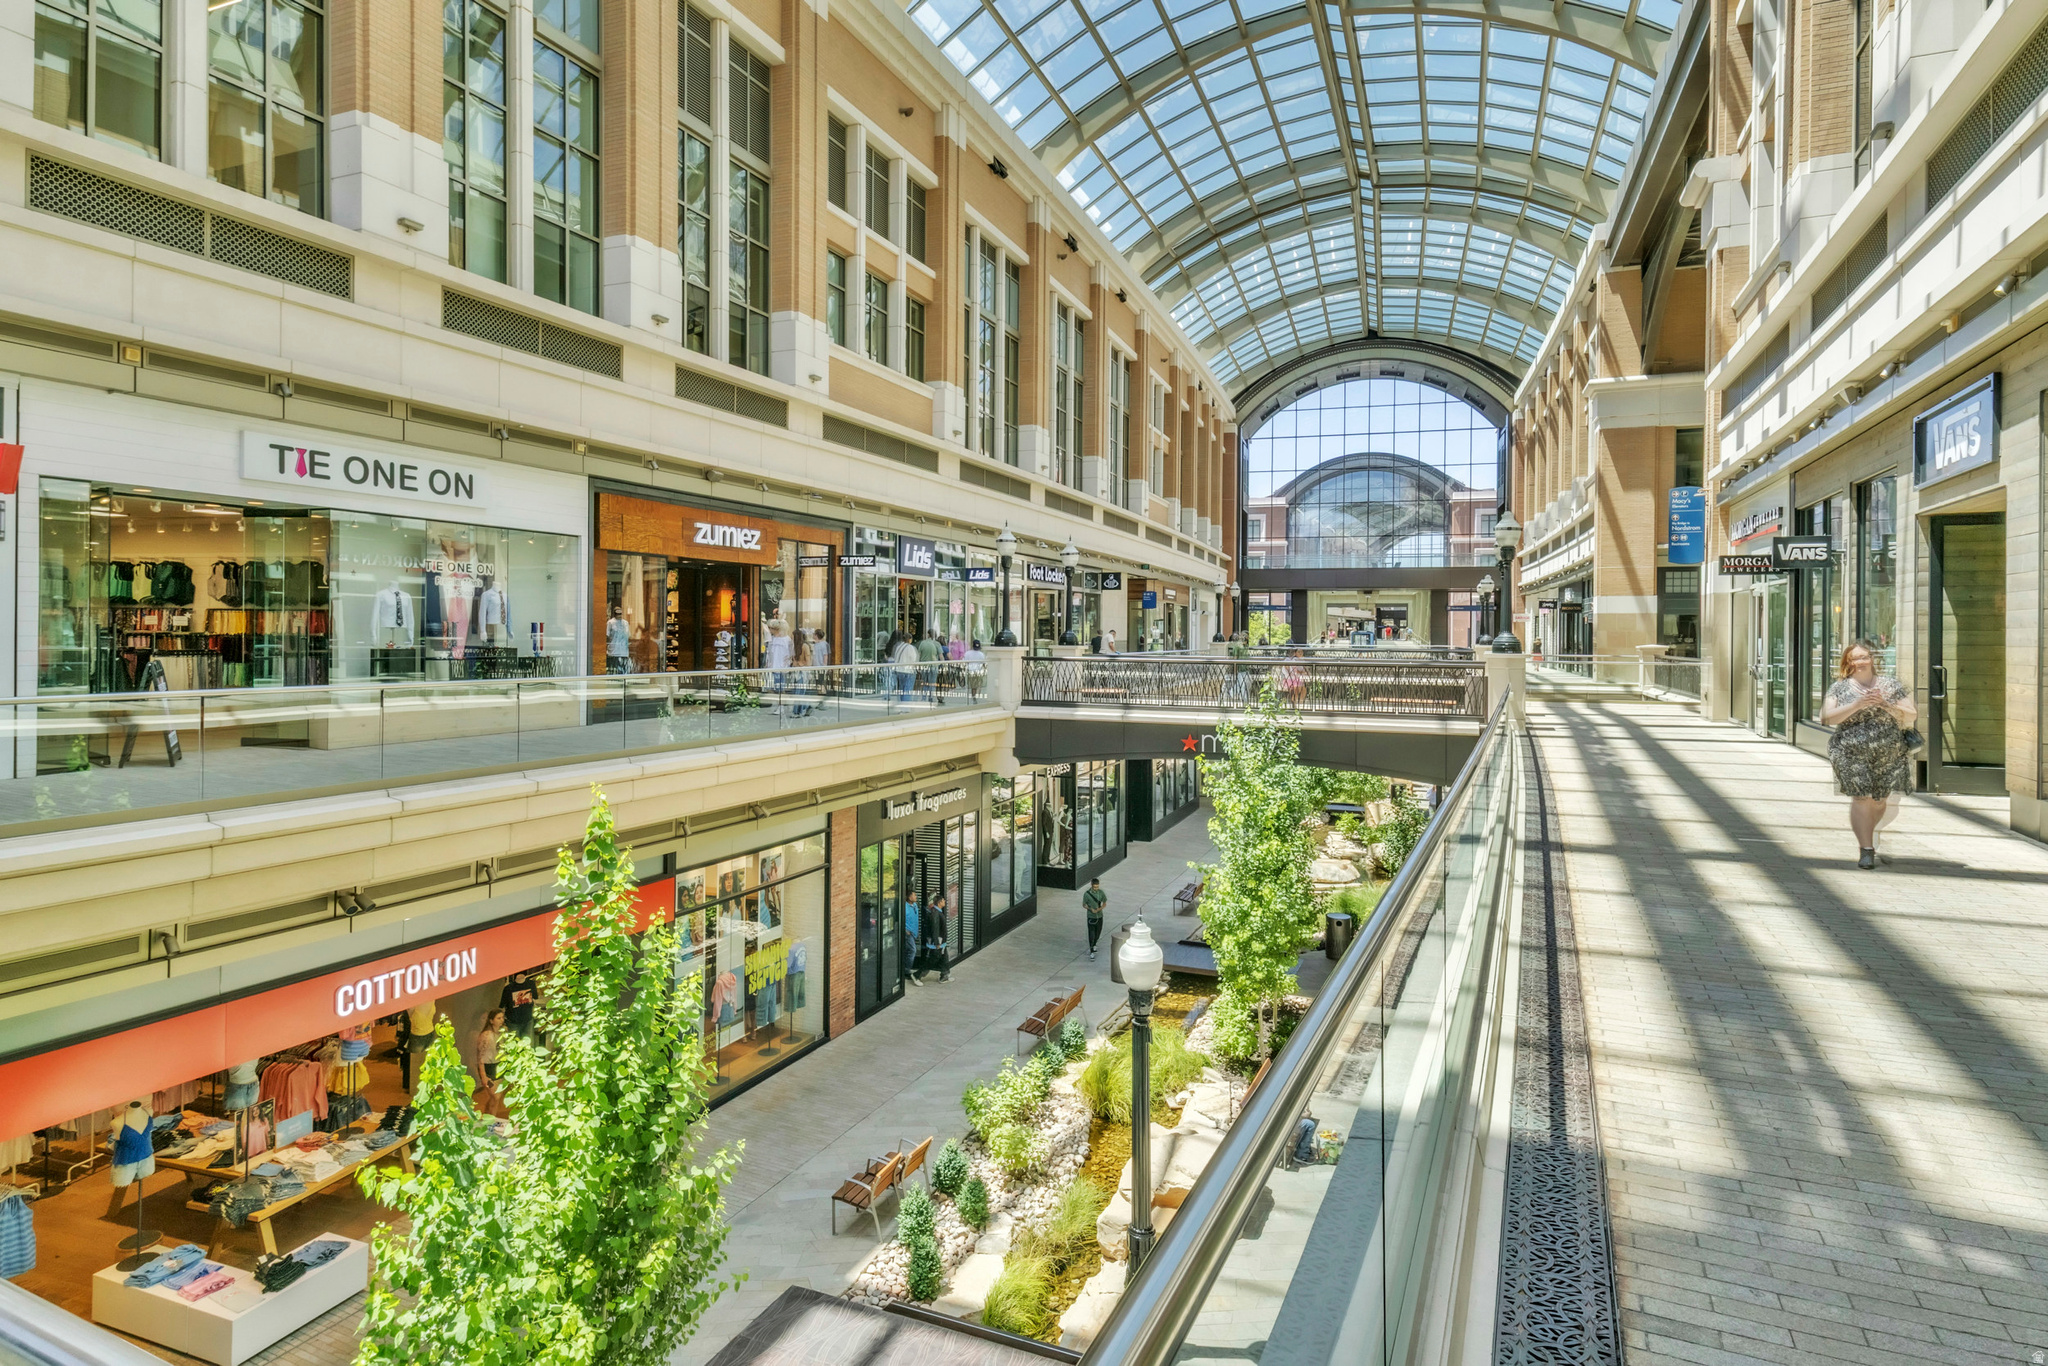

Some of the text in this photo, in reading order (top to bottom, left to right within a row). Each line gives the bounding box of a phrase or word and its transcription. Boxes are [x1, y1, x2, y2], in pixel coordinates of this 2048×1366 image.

[1933, 401, 1981, 470] VANS
[344, 456, 418, 492] ONE
[428, 469, 474, 499] ON
[694, 522, 761, 550] zumiez
[904, 543, 932, 569] Lids
[1778, 543, 1828, 560] VANS
[448, 562, 473, 573] ONE
[477, 564, 493, 574] ON
[840, 556, 874, 566] zumiez
[1723, 557, 1770, 566] MORGA
[969, 570, 989, 580] Lids
[1029, 564, 1044, 581] Foot
[1047, 763, 1071, 777] EXPRESS
[888, 787, 967, 820] luxor fragrances
[336, 947, 477, 1017] COTTON ON
